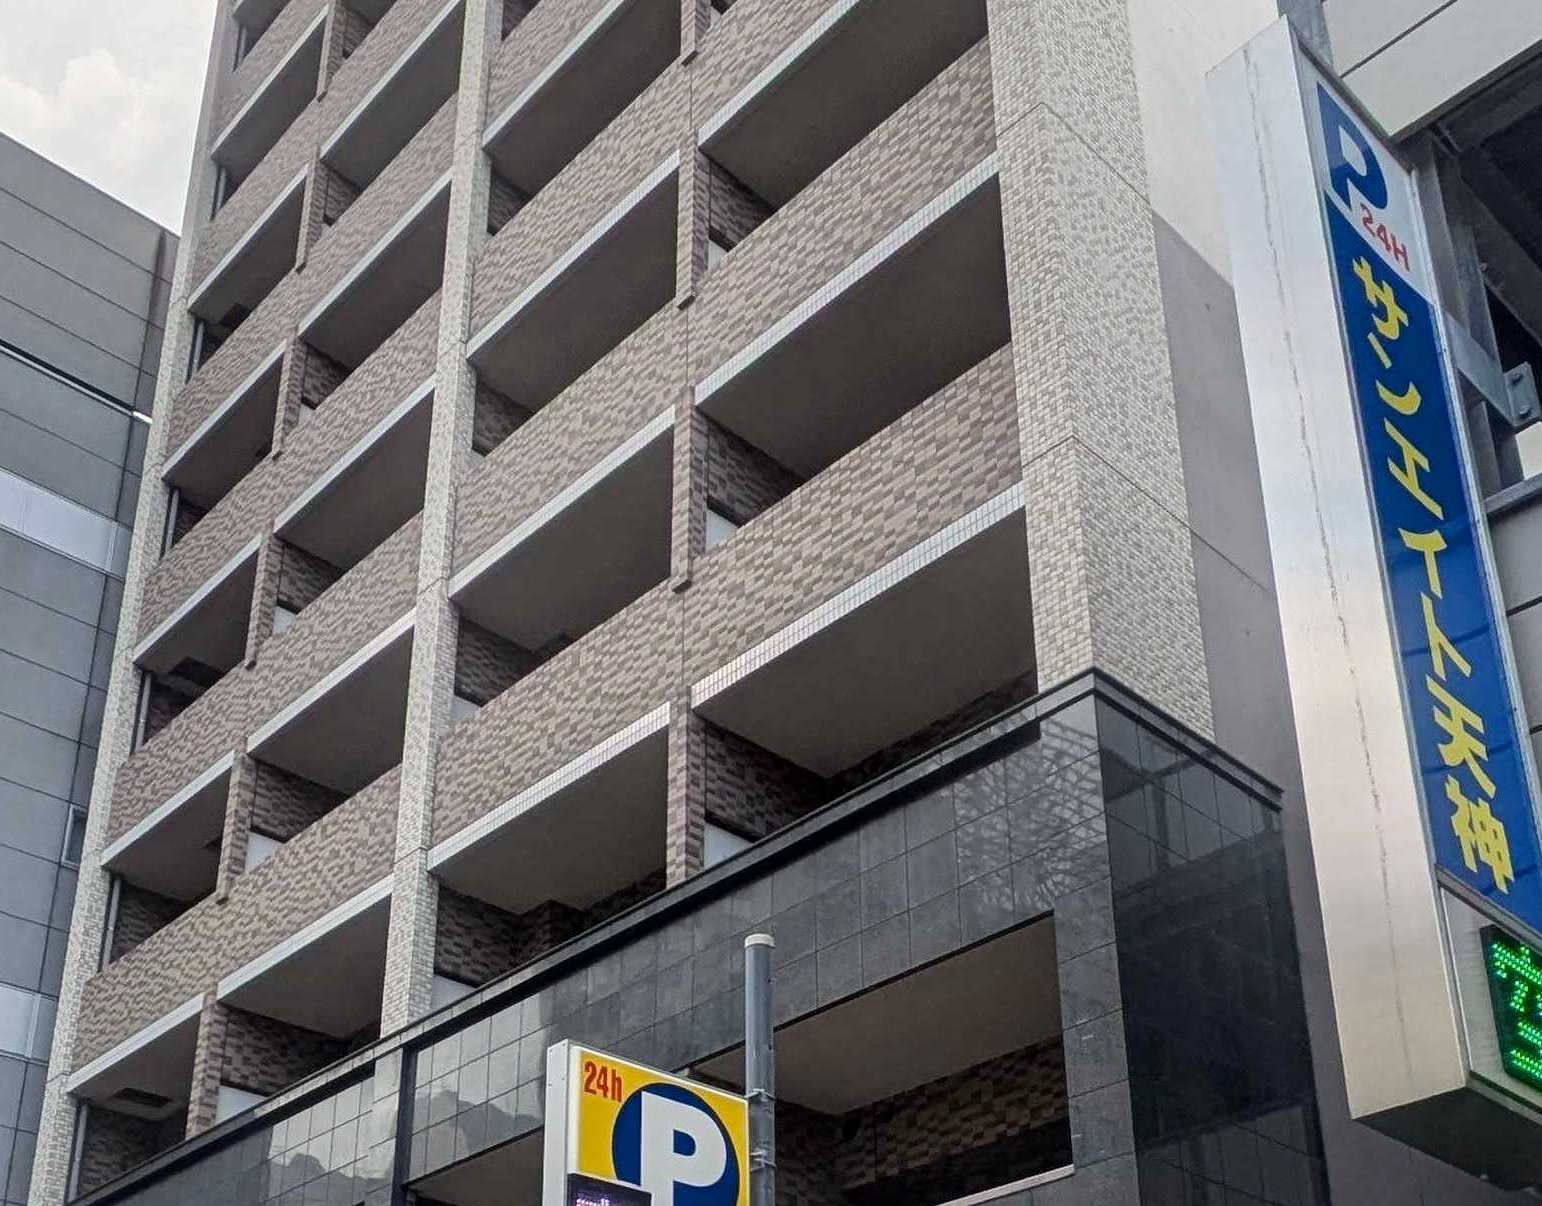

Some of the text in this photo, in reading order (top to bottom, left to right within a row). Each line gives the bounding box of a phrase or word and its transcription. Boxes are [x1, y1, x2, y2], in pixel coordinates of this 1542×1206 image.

[1316, 80, 1390, 212] P
[1361, 204, 1411, 272] 24H
[1352, 256, 1515, 895] サンエイト天神
[584, 1060, 624, 1103] 24h
